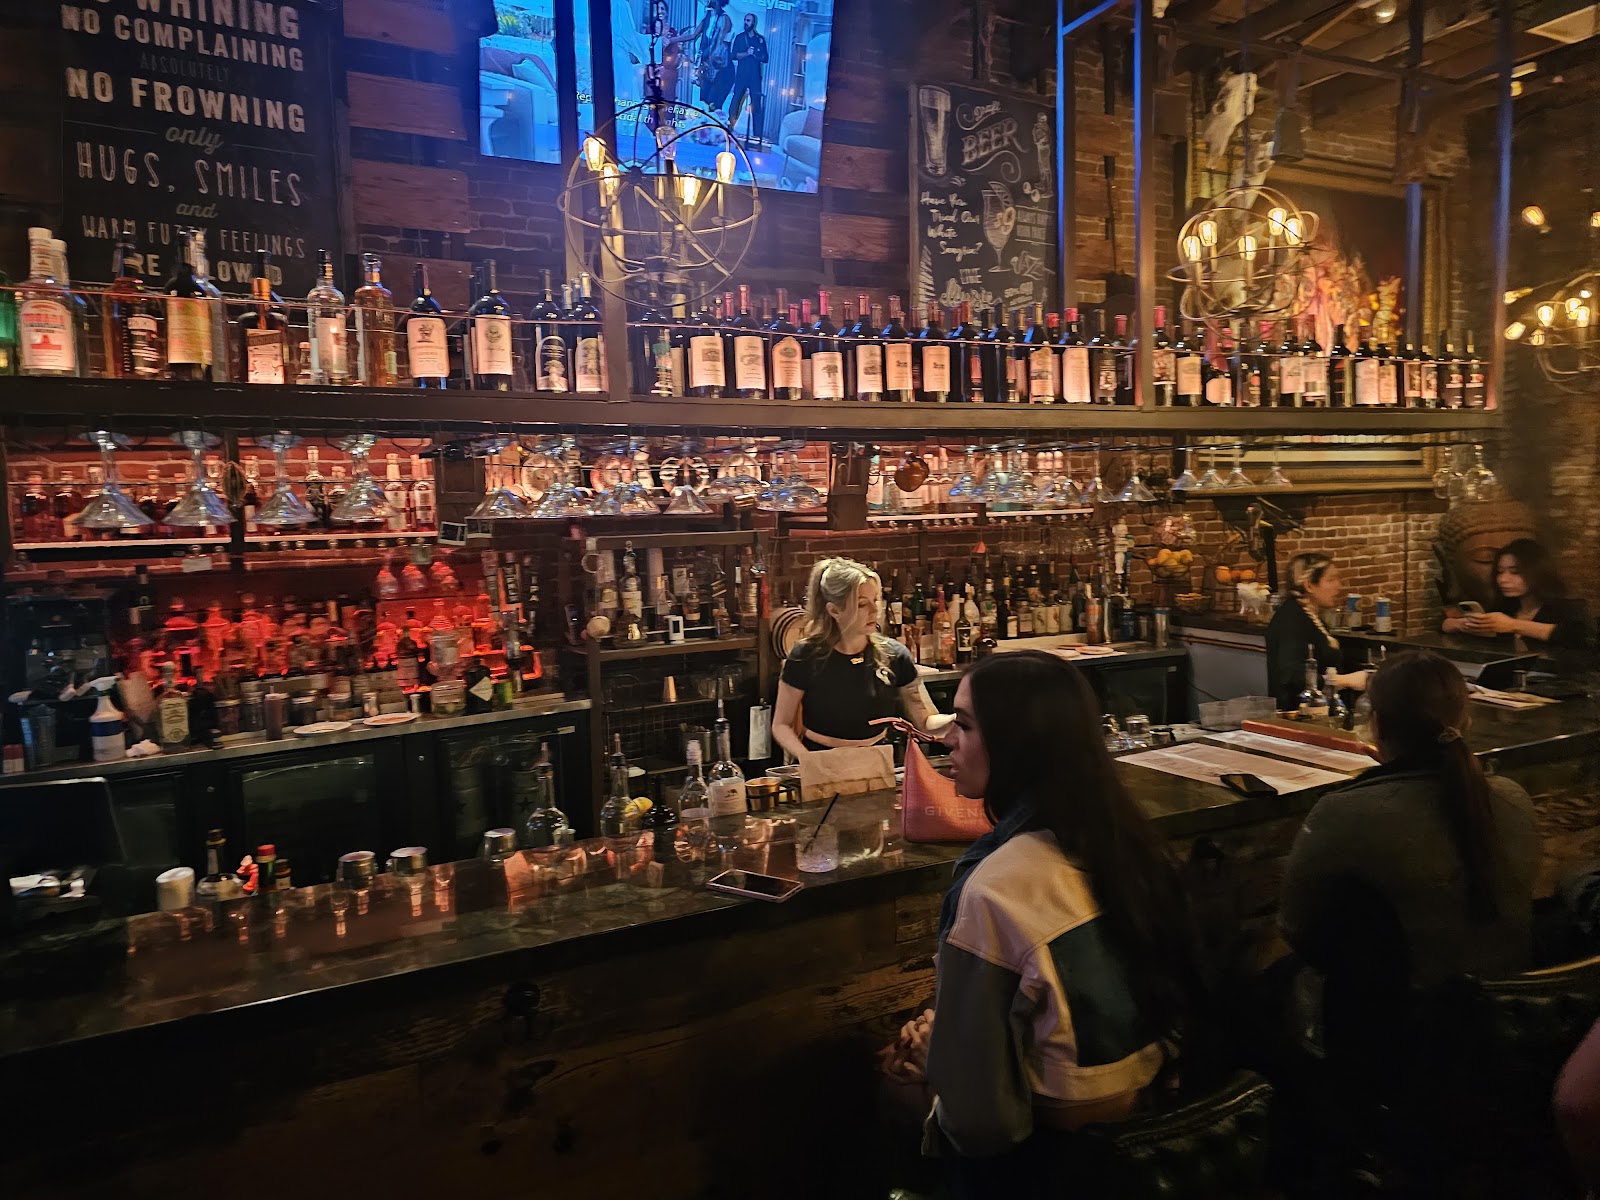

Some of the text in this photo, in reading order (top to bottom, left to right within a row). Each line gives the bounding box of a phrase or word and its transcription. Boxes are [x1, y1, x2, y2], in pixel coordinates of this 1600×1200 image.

[61, 4, 304, 72] NO COMPLAINING
[140, 51, 231, 83] ABSOLUTELY
[66, 67, 306, 133] NO FROWNING
[165, 126, 224, 155] only
[961, 117, 1027, 165] BEER
[77, 141, 301, 207] HUGS, SMILES
[175, 202, 219, 219] and
[81, 215, 137, 239] WARM
[924, 805, 979, 819] GIVEN
